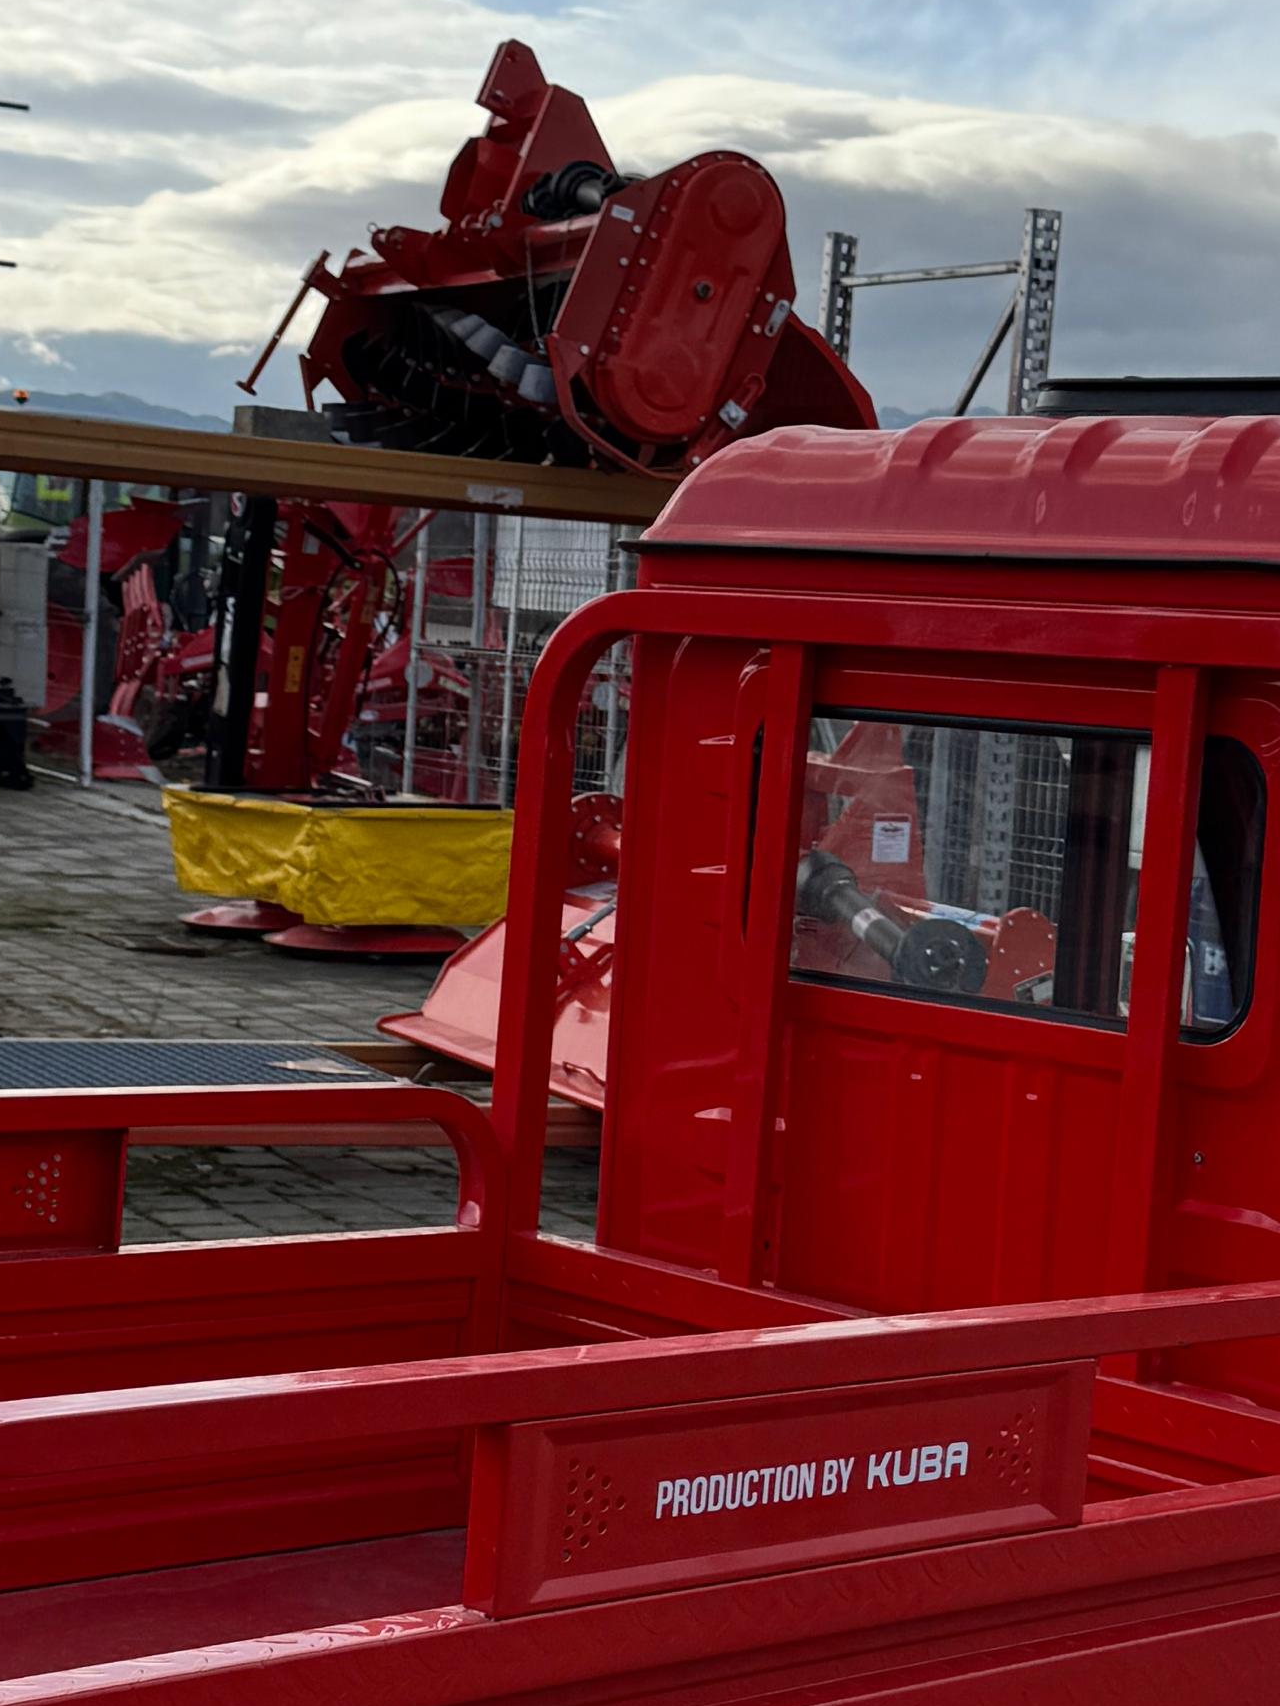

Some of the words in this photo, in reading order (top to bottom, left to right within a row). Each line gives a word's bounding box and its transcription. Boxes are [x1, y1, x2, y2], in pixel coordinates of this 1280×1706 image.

[655, 1461, 817, 1519] PRODUCTION
[821, 1457, 855, 1497] BY
[866, 1441, 969, 1490] KUBA
